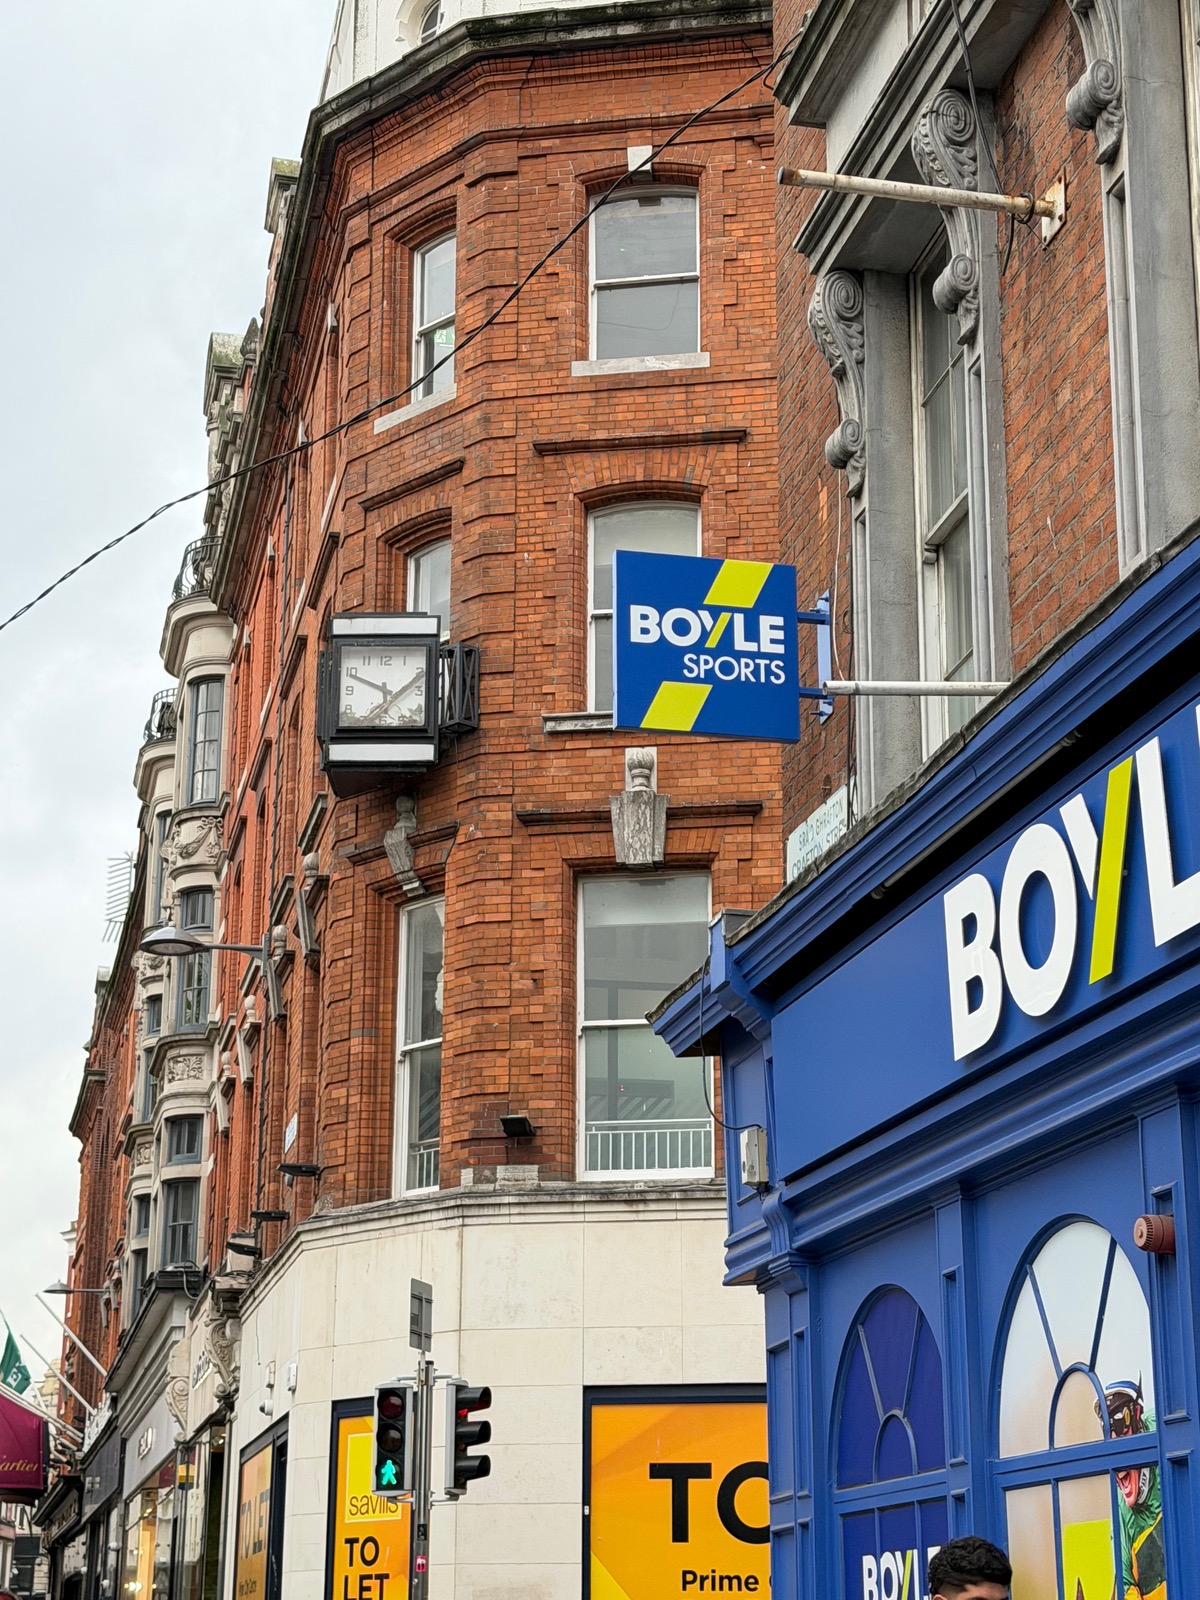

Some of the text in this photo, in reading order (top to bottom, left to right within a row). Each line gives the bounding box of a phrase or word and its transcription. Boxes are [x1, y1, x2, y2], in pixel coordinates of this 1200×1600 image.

[630, 604, 785, 654] BOYLE
[345, 666, 359, 678] 10
[362, 655, 407, 667] 11 12 1
[683, 653, 786, 684] SPORTS
[345, 685, 355, 696] 9
[414, 685, 424, 697] 3
[826, 817, 847, 844] STRE
[944, 704, 1200, 1061] BOYL
[0, 1459, 39, 1471] artier
[349, 1494, 398, 1516] savills
[649, 1461, 770, 1545] TO
[344, 1535, 380, 1567] TO
[344, 1573, 390, 1600] LET
[682, 1569, 760, 1592] Prime
